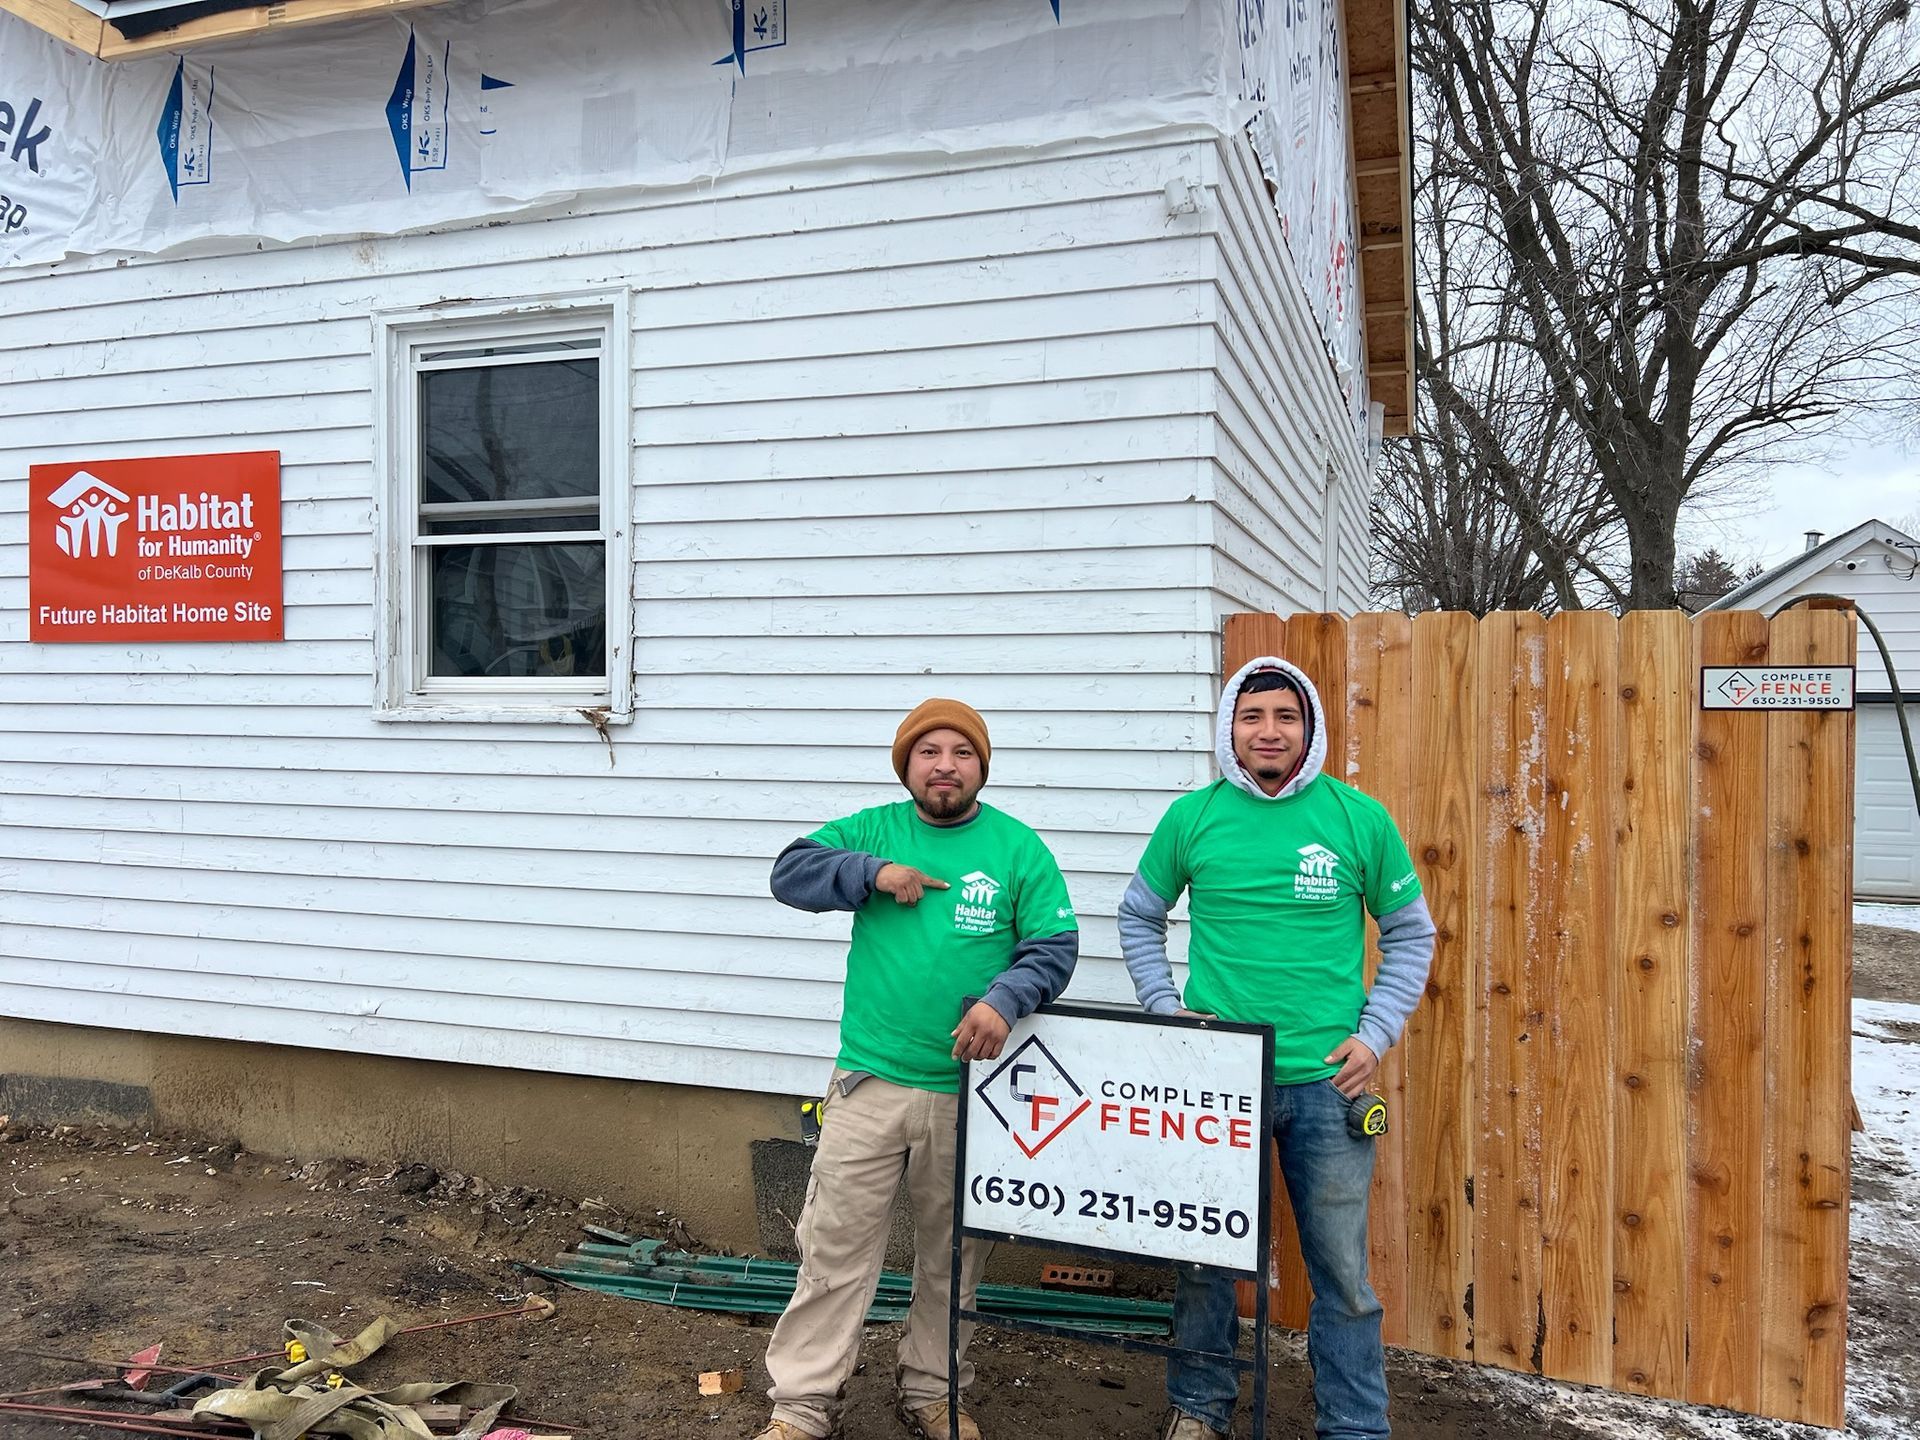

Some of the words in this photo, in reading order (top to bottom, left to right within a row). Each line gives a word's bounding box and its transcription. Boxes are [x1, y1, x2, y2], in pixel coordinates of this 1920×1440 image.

[402, 88, 412, 109] Wrap
[172, 110, 180, 132] Wrap
[401, 112, 409, 130] OKS
[169, 133, 177, 149] OKS
[137, 492, 254, 532] Habitat
[138, 537, 164, 557] for
[138, 566, 152, 581] of
[154, 564, 202, 580] DeKalb
[205, 563, 253, 581] County
[39, 605, 97, 625] Future
[102, 603, 167, 624] Habitat
[173, 602, 229, 623] Home
[234, 601, 272, 622] Site
[1761, 673, 1832, 681] COMPLETE
[1761, 683, 1832, 694] FENCE
[1752, 697, 1841, 705] 630-231-9550
[1294, 874, 1338, 886] Habitat
[1306, 886, 1339, 894] Humanity
[955, 904, 996, 919] Habitat
[966, 916, 996, 927] Humanity
[1100, 1080, 1252, 1114] COMPLETE
[1100, 1103, 1252, 1149] FENCE
[970, 1174, 1066, 1217] (630)
[1078, 1189, 1251, 1240] 231-9550
